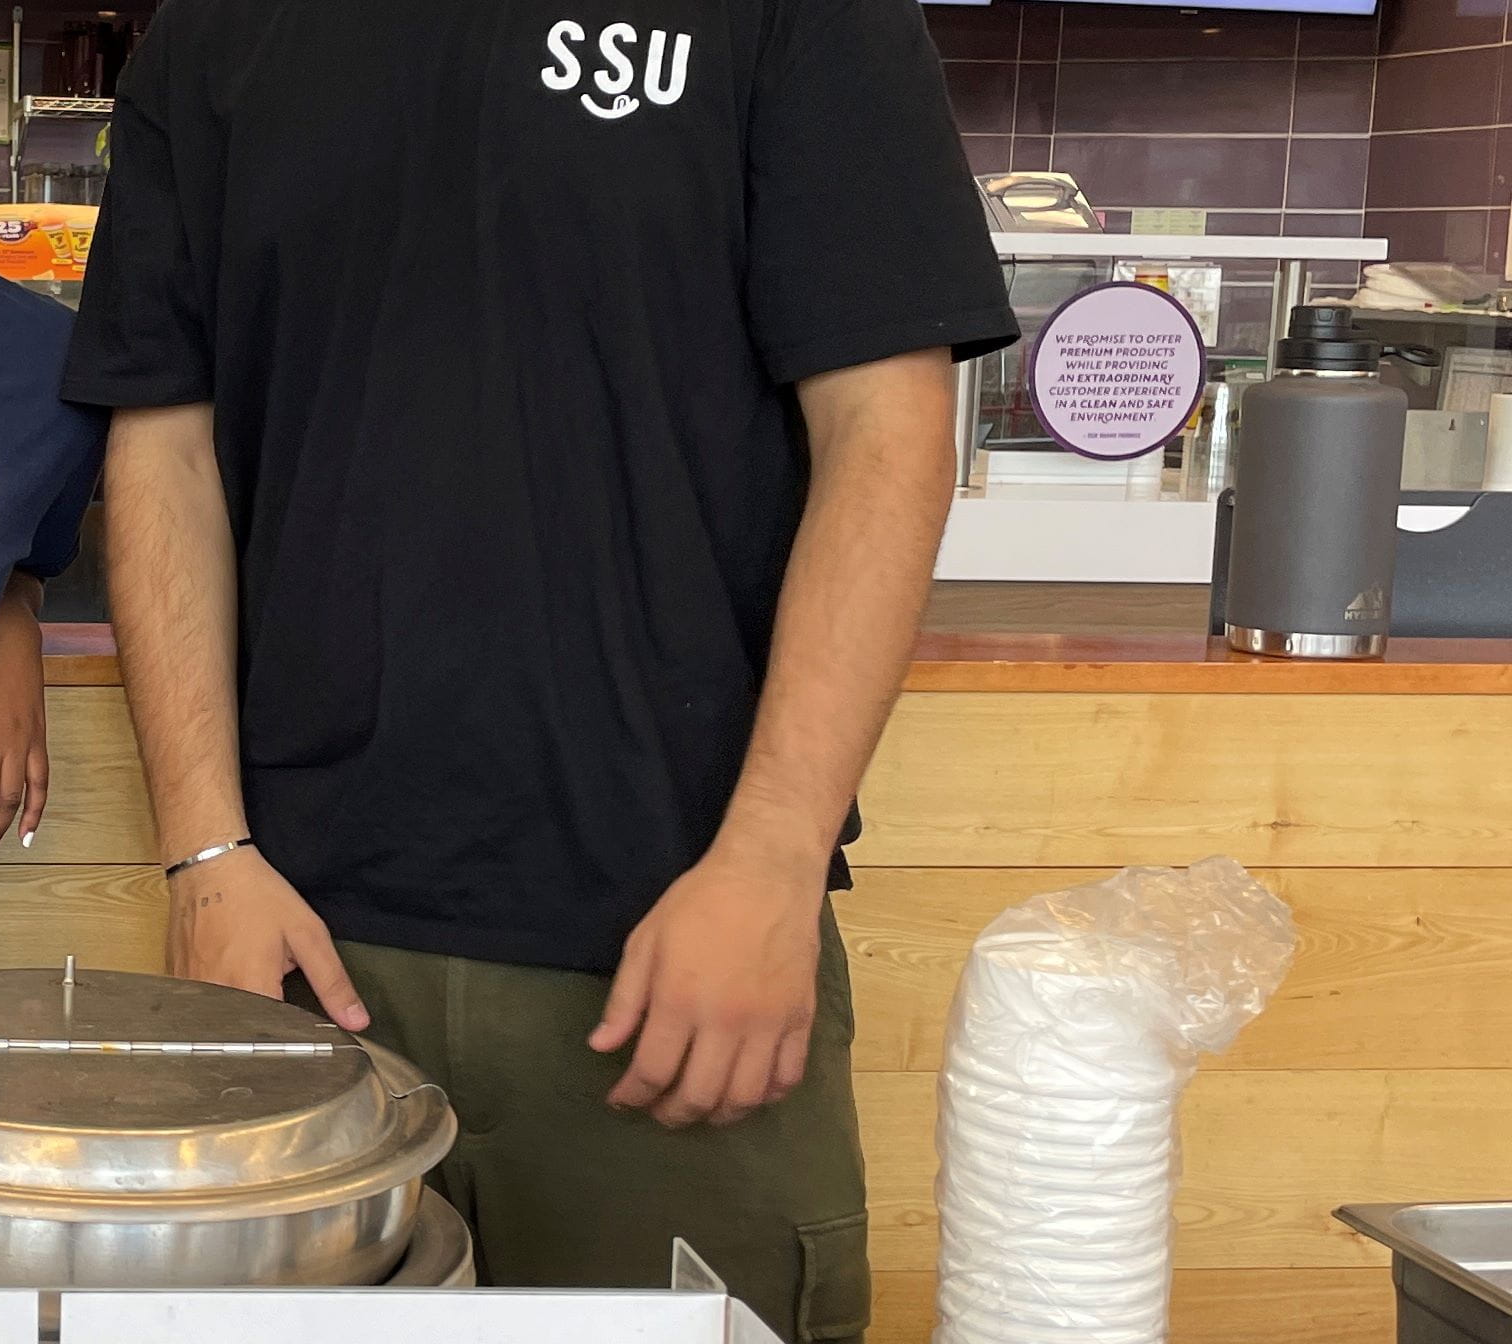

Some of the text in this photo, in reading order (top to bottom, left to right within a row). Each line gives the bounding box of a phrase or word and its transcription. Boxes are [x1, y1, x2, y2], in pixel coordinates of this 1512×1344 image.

[541, 20, 692, 105] SSU
[1055, 334, 1182, 346] WE PROMISE TO OFFER
[1059, 347, 1176, 357] PREMIUM PRODUCTS
[1065, 360, 1169, 370] WHILE PROVIDING
[1057, 373, 1175, 385] AN EXTRAORDINARY
[1048, 386, 1182, 396] CUSTOMER EXPERIENCE
[1055, 399, 1174, 409] IN A CLEAN AND SAFE
